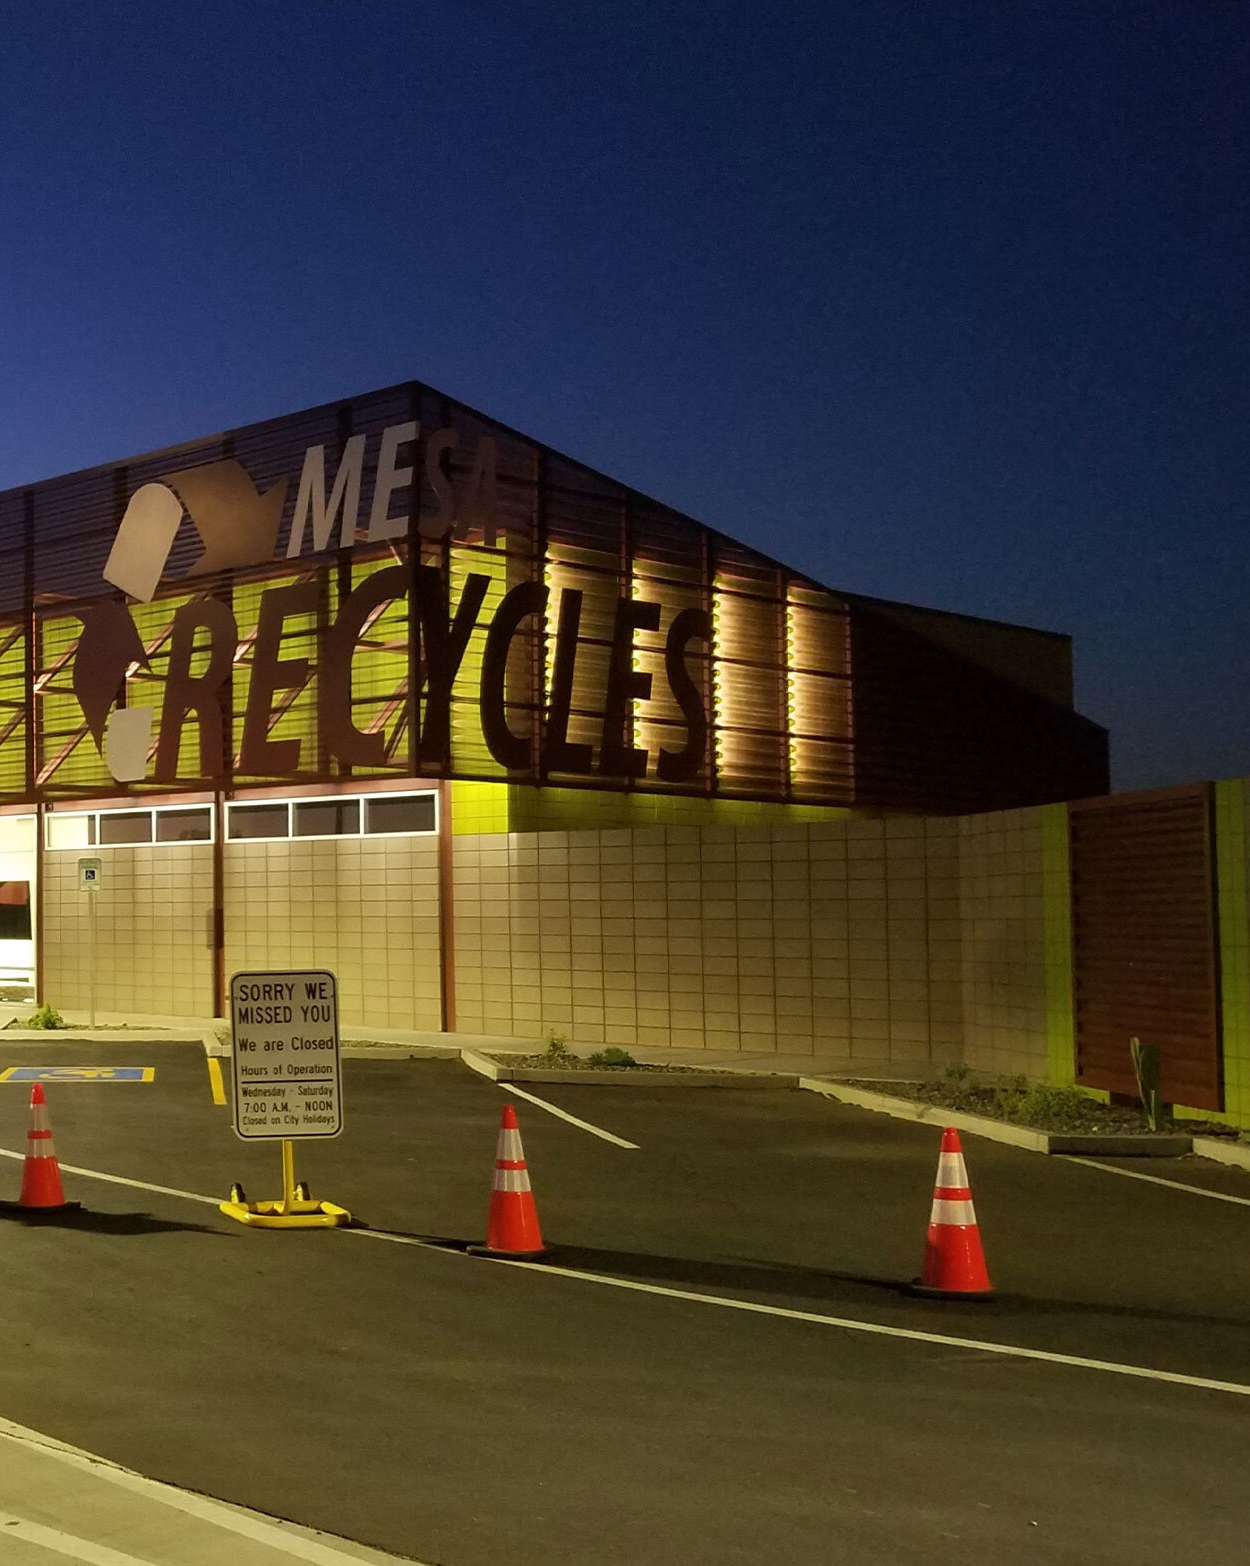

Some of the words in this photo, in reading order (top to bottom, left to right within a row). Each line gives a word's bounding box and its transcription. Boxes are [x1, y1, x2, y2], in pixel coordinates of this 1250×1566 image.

[286, 420, 497, 559] MESA
[154, 564, 714, 782] RECYCLES
[239, 983, 295, 1001] SORRY
[304, 982, 328, 1000] WE
[238, 1006, 292, 1024] MISSED
[300, 1005, 330, 1023] YOU
[238, 1037, 256, 1051] We
[263, 1040, 284, 1051] are
[291, 1036, 334, 1050] Closed
[241, 1065, 268, 1076] Hours
[273, 1064, 282, 1075] of
[287, 1063, 332, 1076] Operation
[241, 1087, 286, 1098] Wednesday
[298, 1085, 333, 1097] Saturday
[244, 1102, 267, 1113] 7:00
[272, 1102, 291, 1112] A.M.
[305, 1100, 333, 1111] NOON
[242, 1116, 267, 1125] Closed
[284, 1115, 299, 1125] City
[303, 1114, 335, 1125] Holidays
